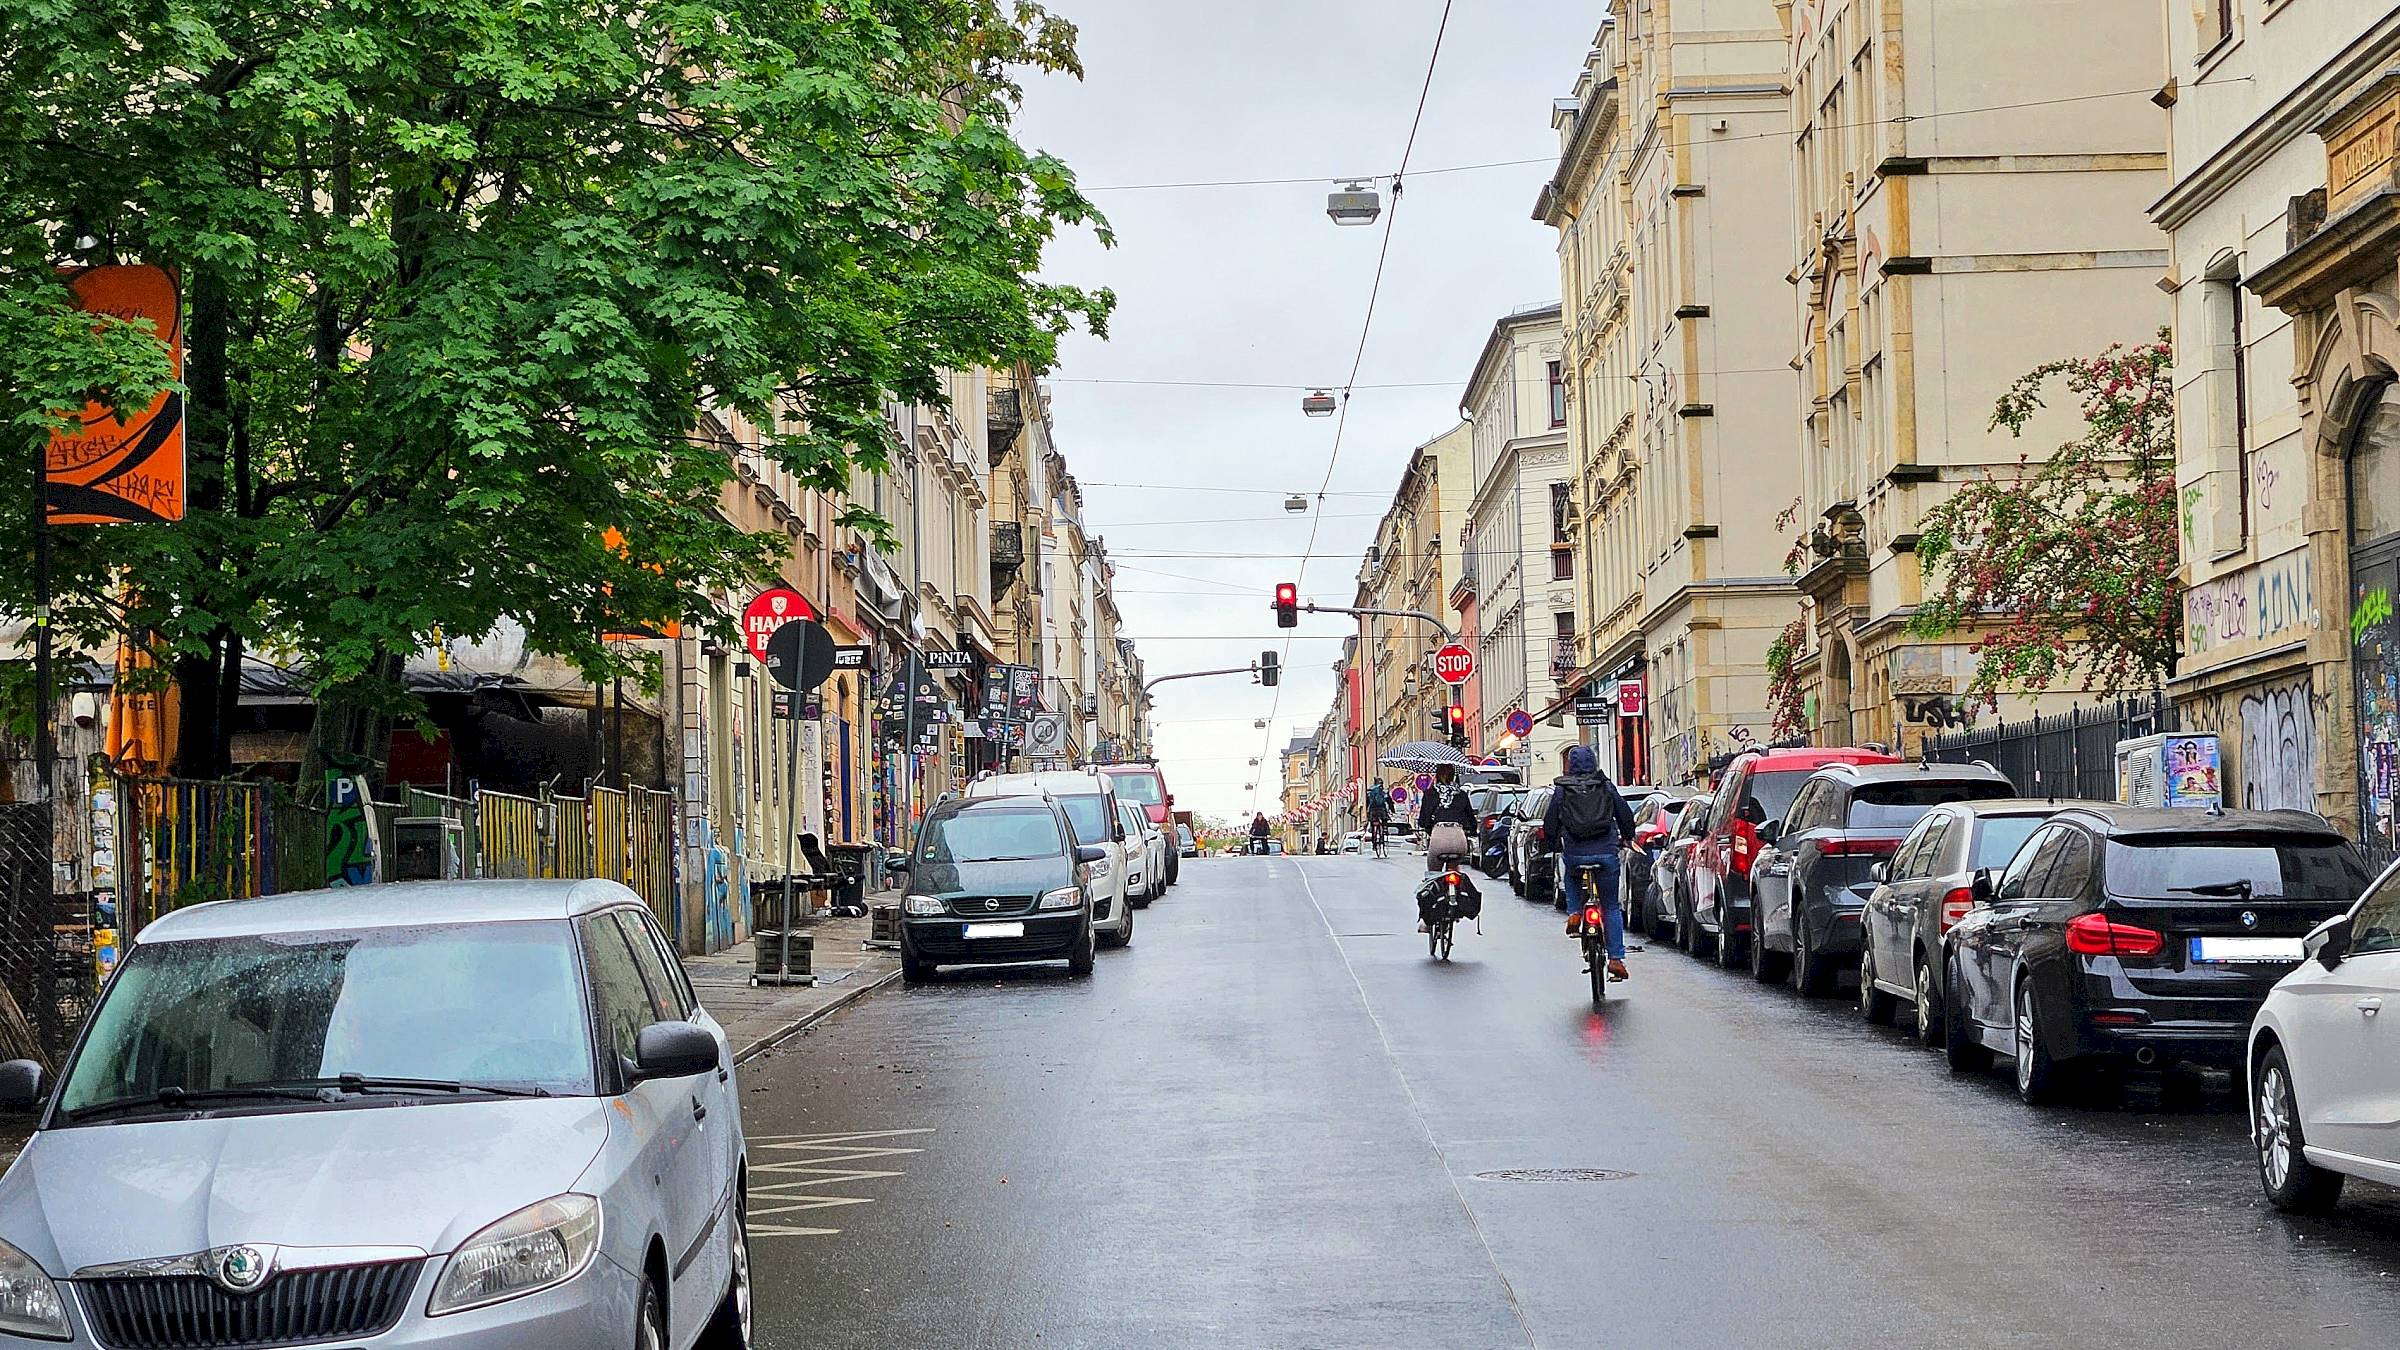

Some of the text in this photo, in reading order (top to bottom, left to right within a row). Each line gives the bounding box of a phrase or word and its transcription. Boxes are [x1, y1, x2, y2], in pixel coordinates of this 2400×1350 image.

[1437, 654, 1471, 672] STOP
[1037, 725, 1053, 738] 20
[336, 777, 354, 804] P
